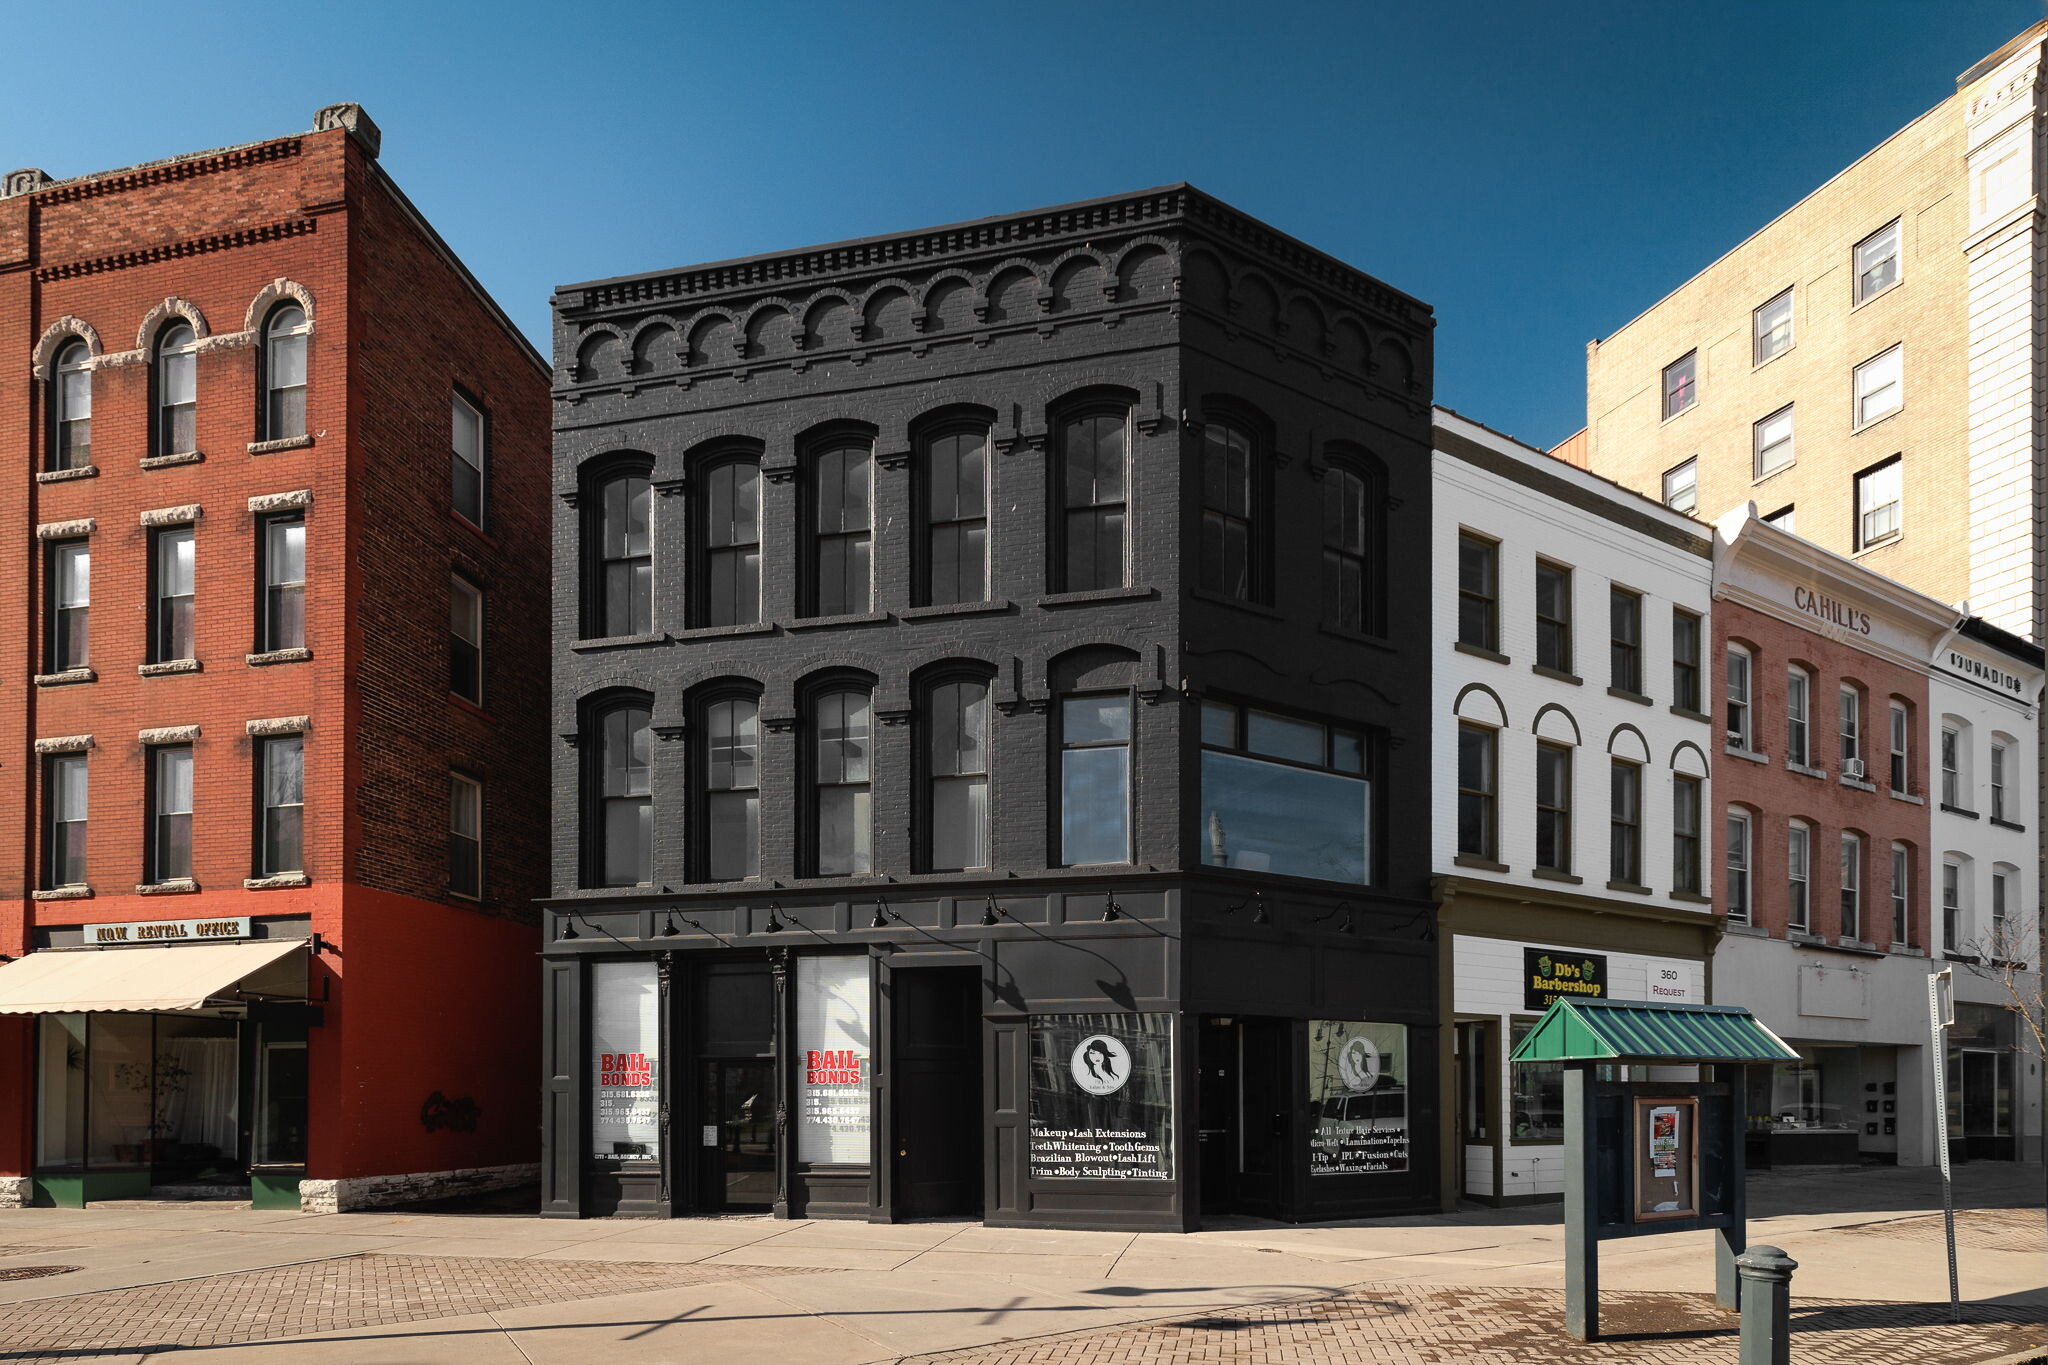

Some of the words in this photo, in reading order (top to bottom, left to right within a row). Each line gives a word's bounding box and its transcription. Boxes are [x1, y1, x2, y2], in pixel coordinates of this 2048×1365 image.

[1794, 586, 1871, 635] CAHILL'S
[137, 924, 188, 939] RENTAL
[196, 921, 240, 937] OFFICE
[1554, 963, 1580, 978] Db's
[1660, 969, 1678, 980] 360
[1532, 975, 1601, 997] Barbershop
[1652, 985, 1686, 997] REQUEST
[600, 1053, 650, 1072] BAIL
[806, 1050, 860, 1070] BAIL
[600, 1072, 651, 1087] BONDS
[806, 1070, 860, 1085] BONDS
[1030, 1128, 1068, 1139] Makeup
[1073, 1129, 1093, 1138] Lash
[1095, 1129, 1147, 1139] Extensions
[1320, 1127, 1332, 1136] All
[1356, 1126, 1371, 1135] Hair
[1372, 1125, 1396, 1134] Services
[1345, 1137, 1384, 1146] Lamination
[1030, 1154, 1072, 1163] Brazilian
[1075, 1153, 1113, 1163] Blowout
[1341, 1152, 1354, 1160] IPL
[1361, 1151, 1389, 1160] Fusion
[1393, 1149, 1409, 1158] Cuts
[1030, 1167, 1053, 1176] Trim
[1059, 1167, 1081, 1178] Body
[1082, 1167, 1126, 1179] Sculpting
[1131, 1168, 1168, 1179] Tinting
[1339, 1163, 1364, 1173] Waxing
[1366, 1161, 1388, 1171] Facials
